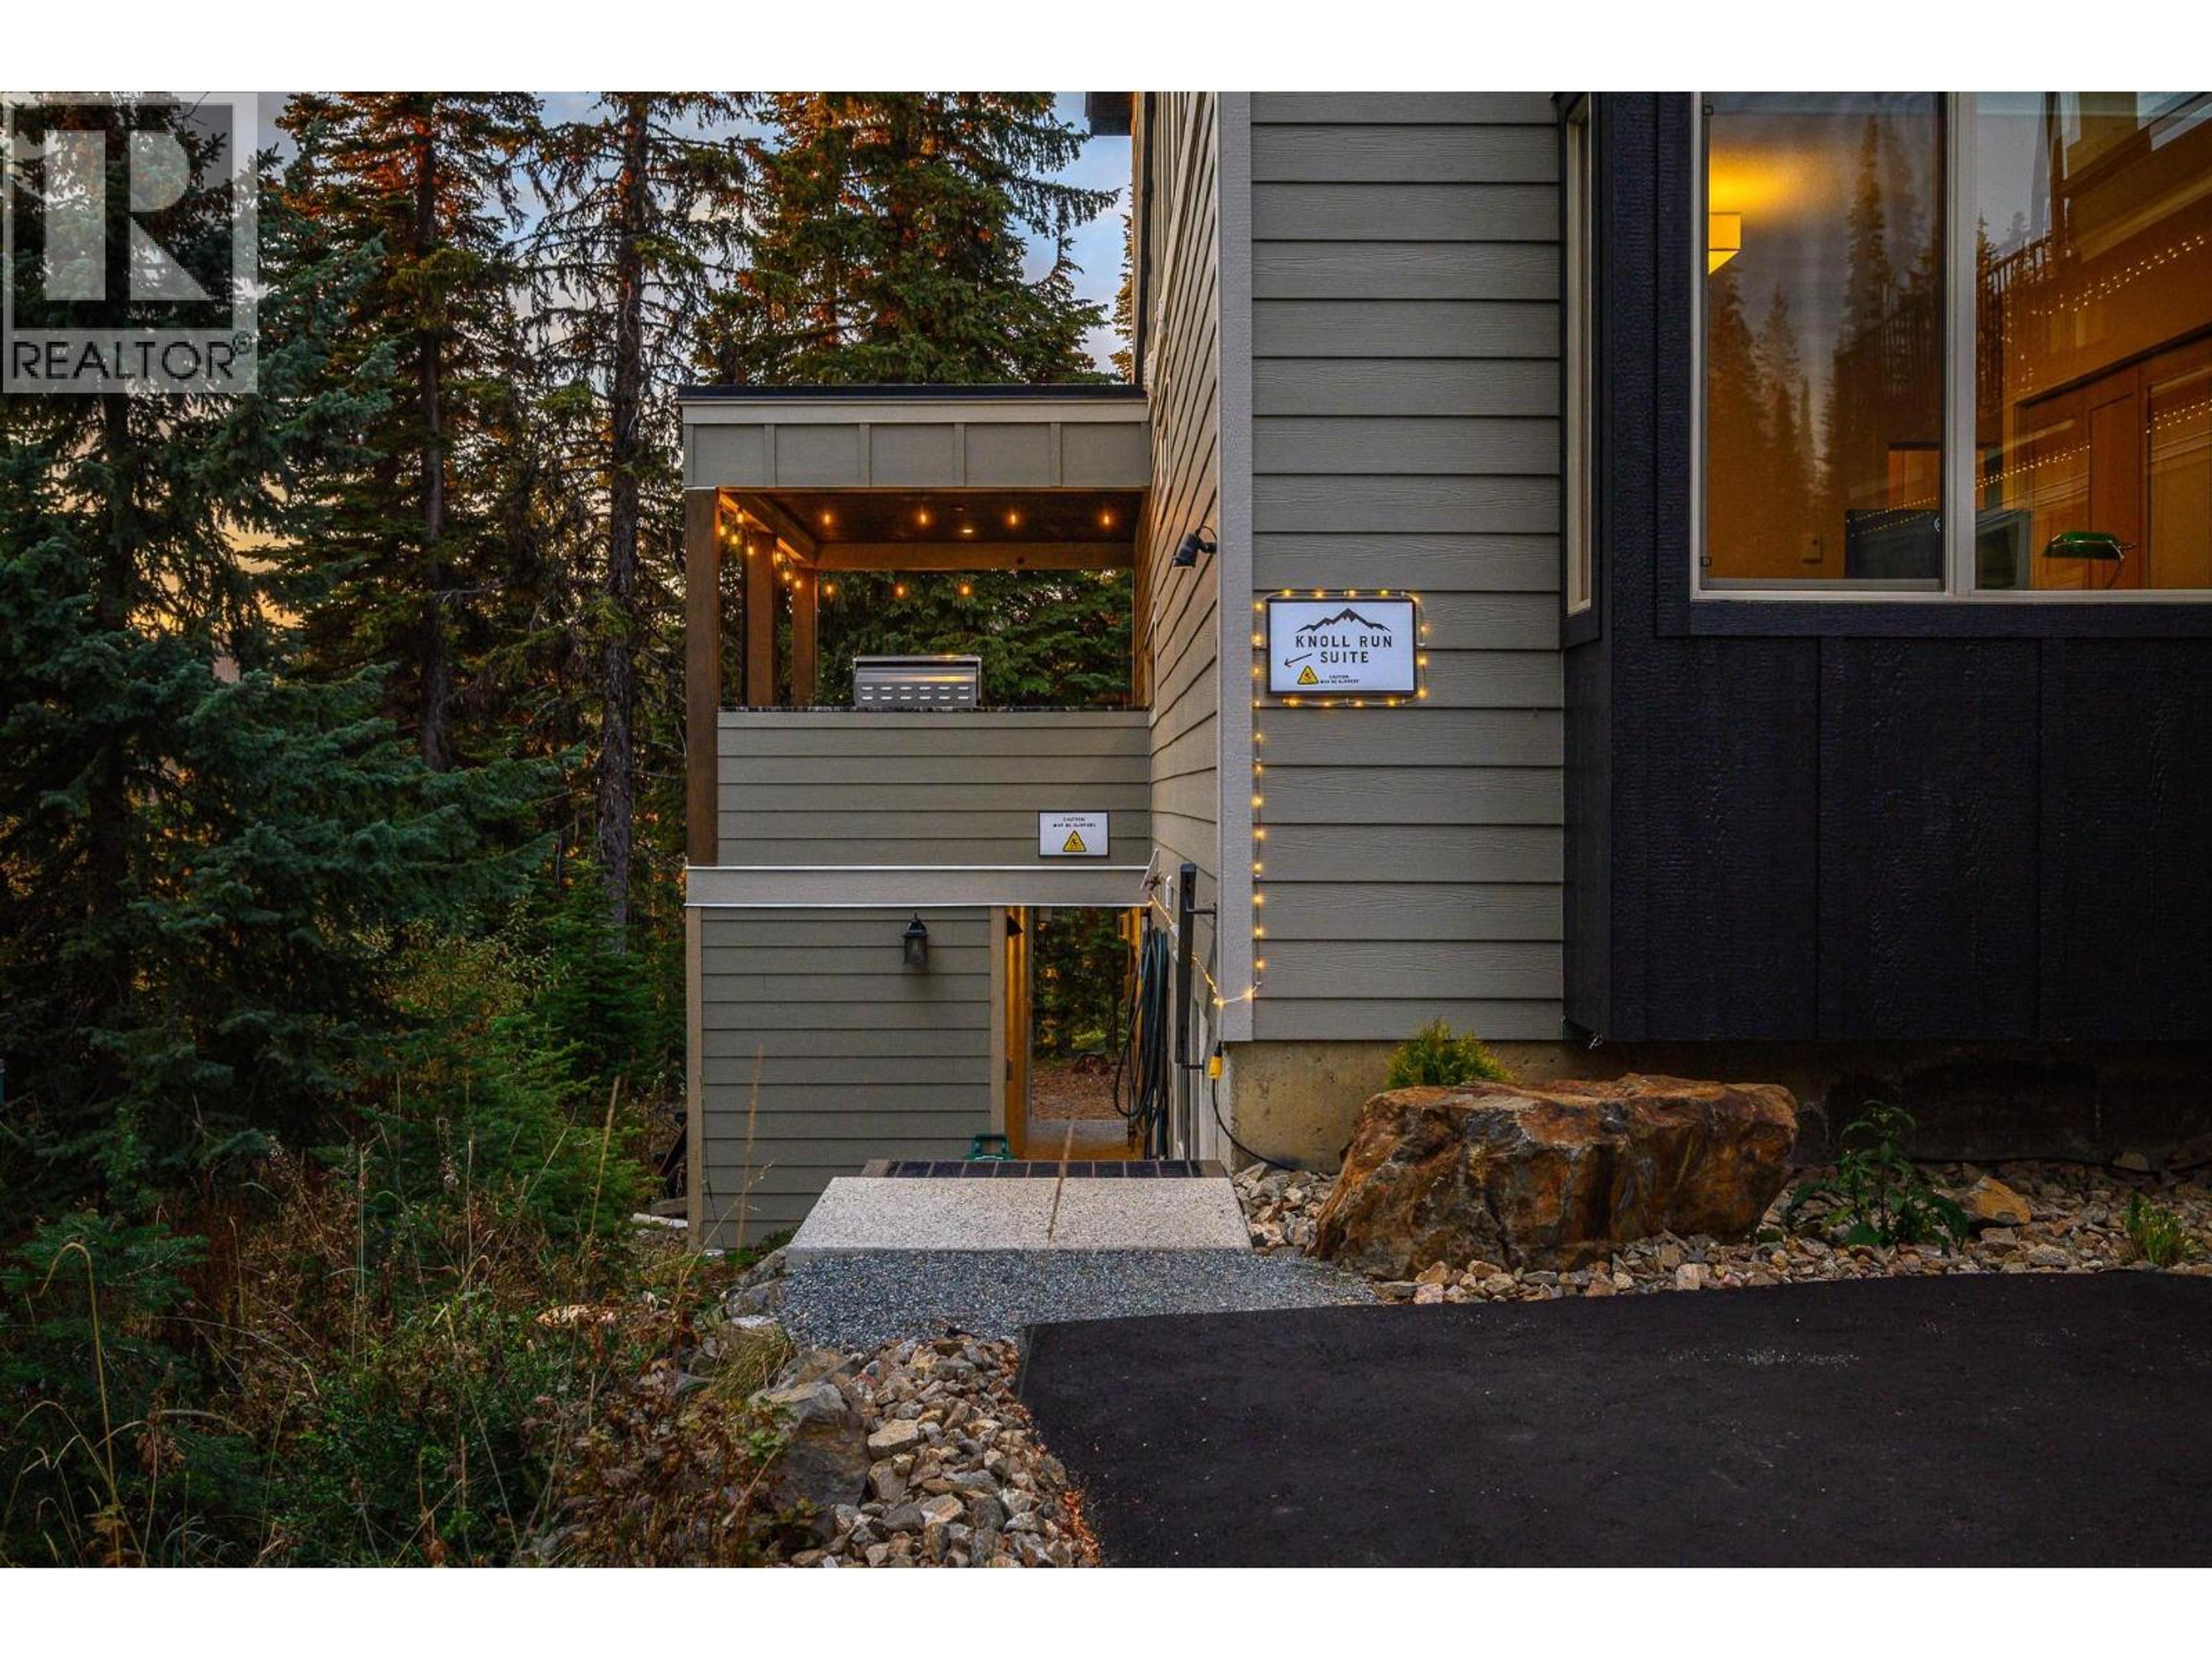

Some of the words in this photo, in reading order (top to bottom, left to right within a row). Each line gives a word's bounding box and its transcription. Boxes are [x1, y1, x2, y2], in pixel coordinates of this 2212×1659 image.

[1296, 635, 1350, 647] KNOLL
[1359, 635, 1392, 647] RUN
[1320, 651, 1369, 663] SUITE
